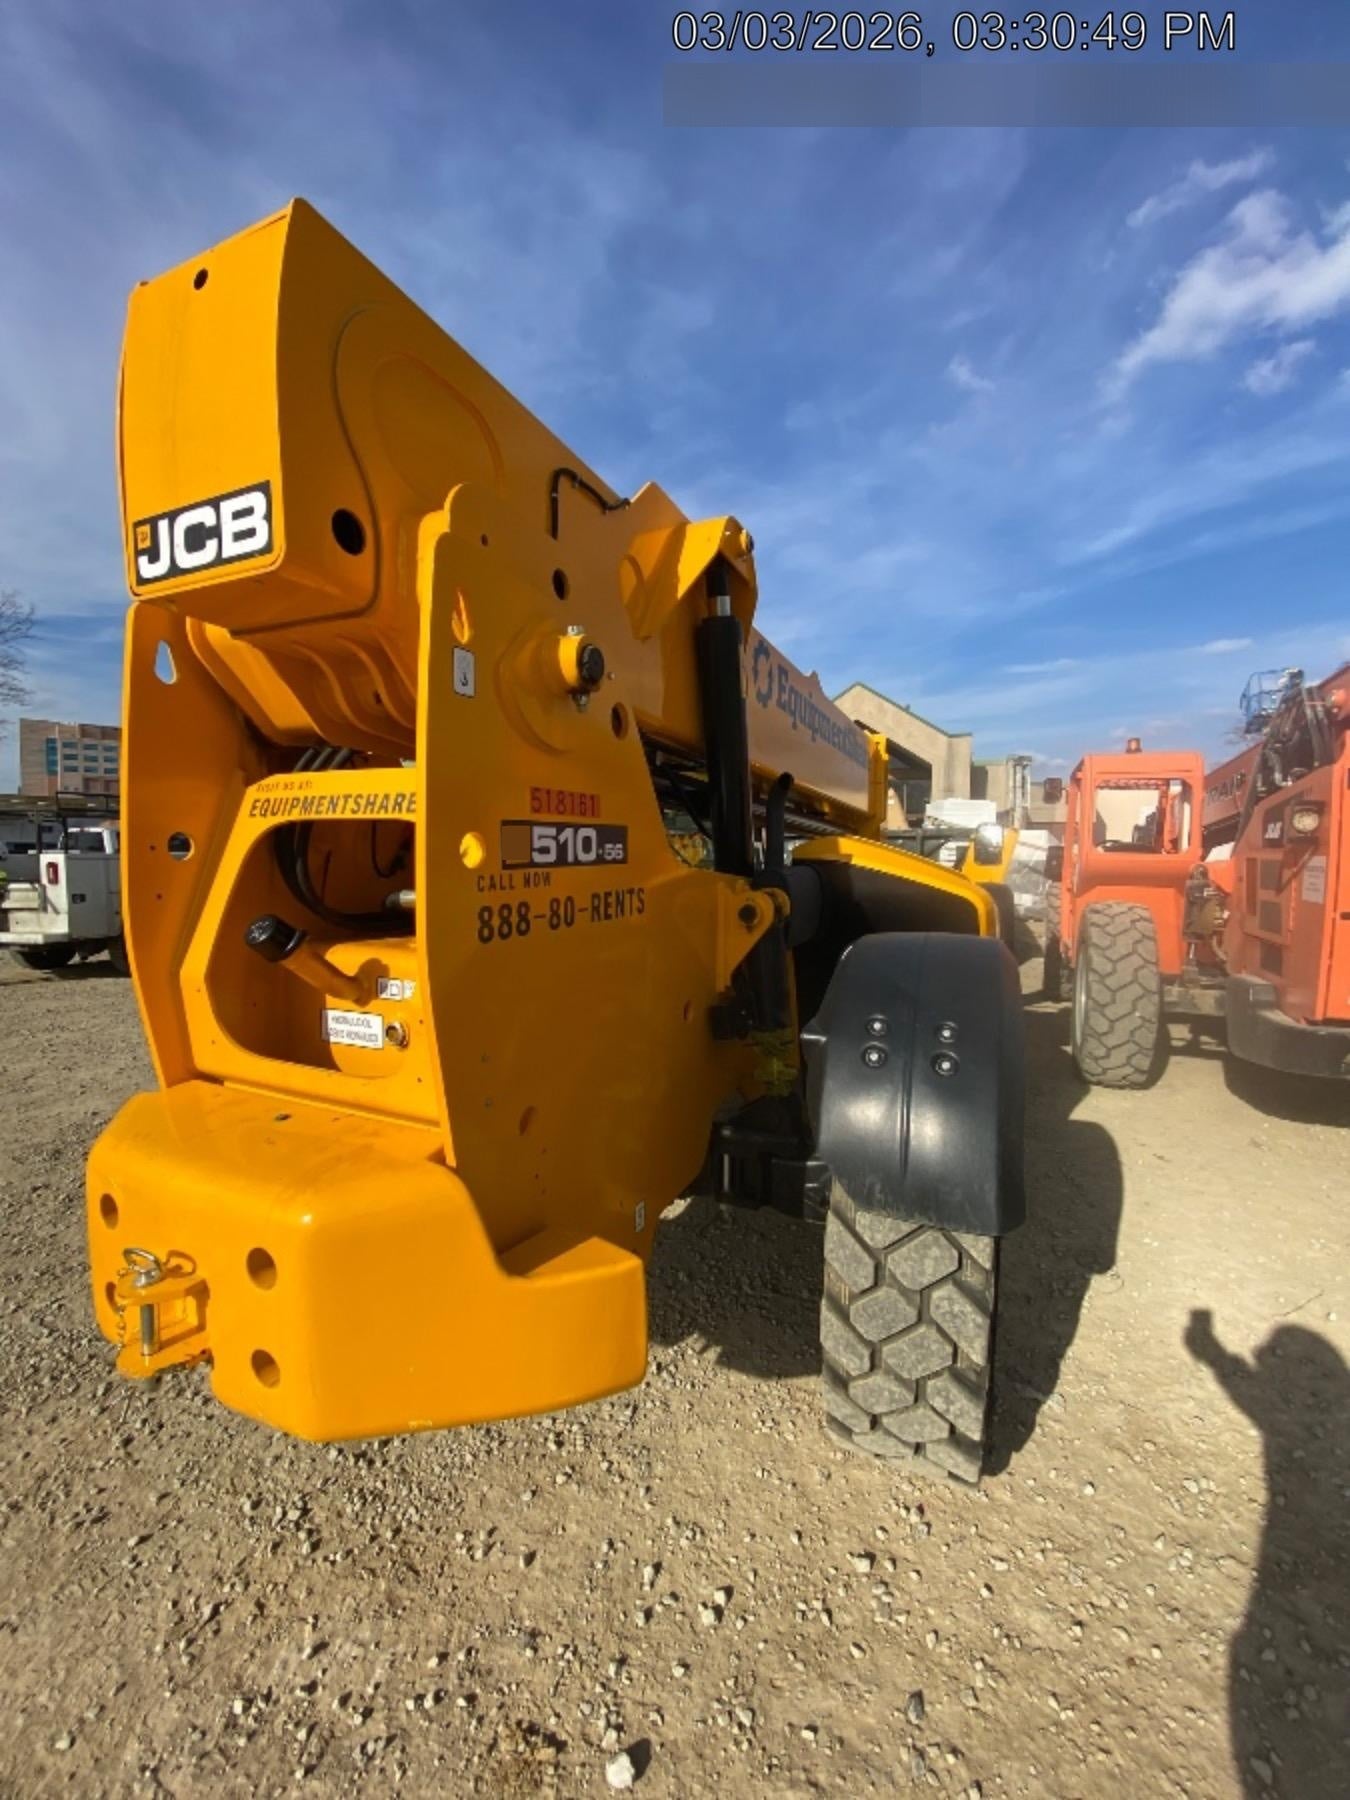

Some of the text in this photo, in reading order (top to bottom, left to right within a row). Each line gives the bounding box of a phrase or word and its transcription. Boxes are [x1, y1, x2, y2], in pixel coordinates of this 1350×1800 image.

[137, 490, 270, 580] JCB
[776, 663, 869, 770] Equipmen
[248, 791, 416, 819] EQUIPMENTSHARE
[477, 871, 551, 893] CALL NOW
[477, 887, 646, 944] 888-80-RENTS
